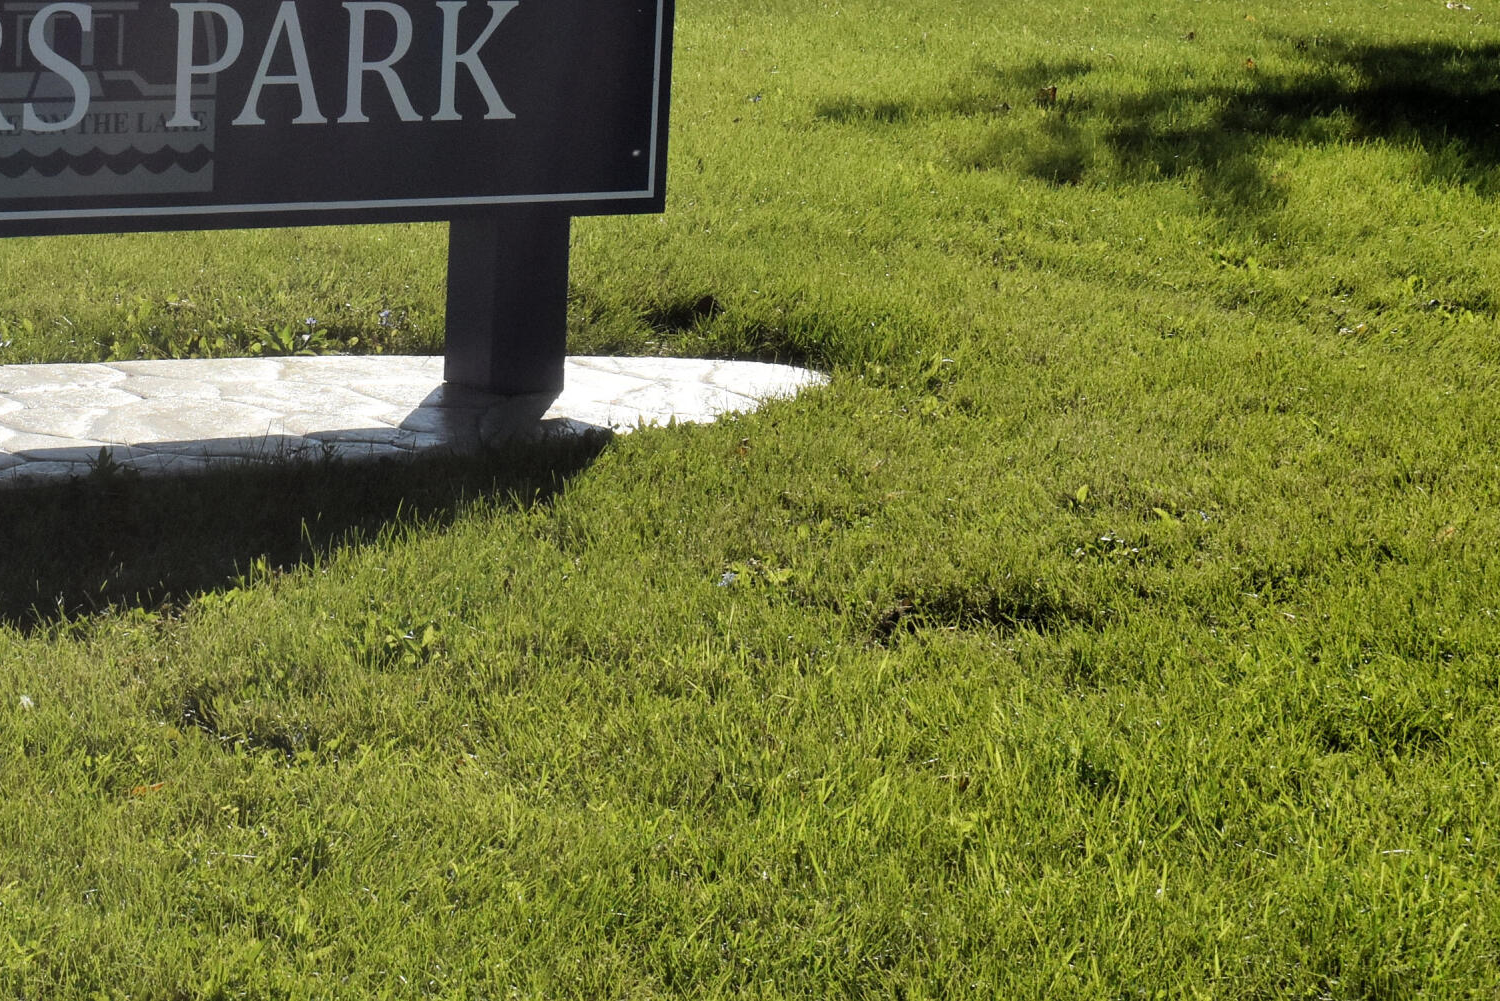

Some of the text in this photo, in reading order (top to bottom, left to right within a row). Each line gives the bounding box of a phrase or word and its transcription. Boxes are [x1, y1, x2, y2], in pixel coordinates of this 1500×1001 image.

[165, 0, 520, 128] PARK
[76, 112, 129, 135] THE
[136, 111, 208, 133] LAE
